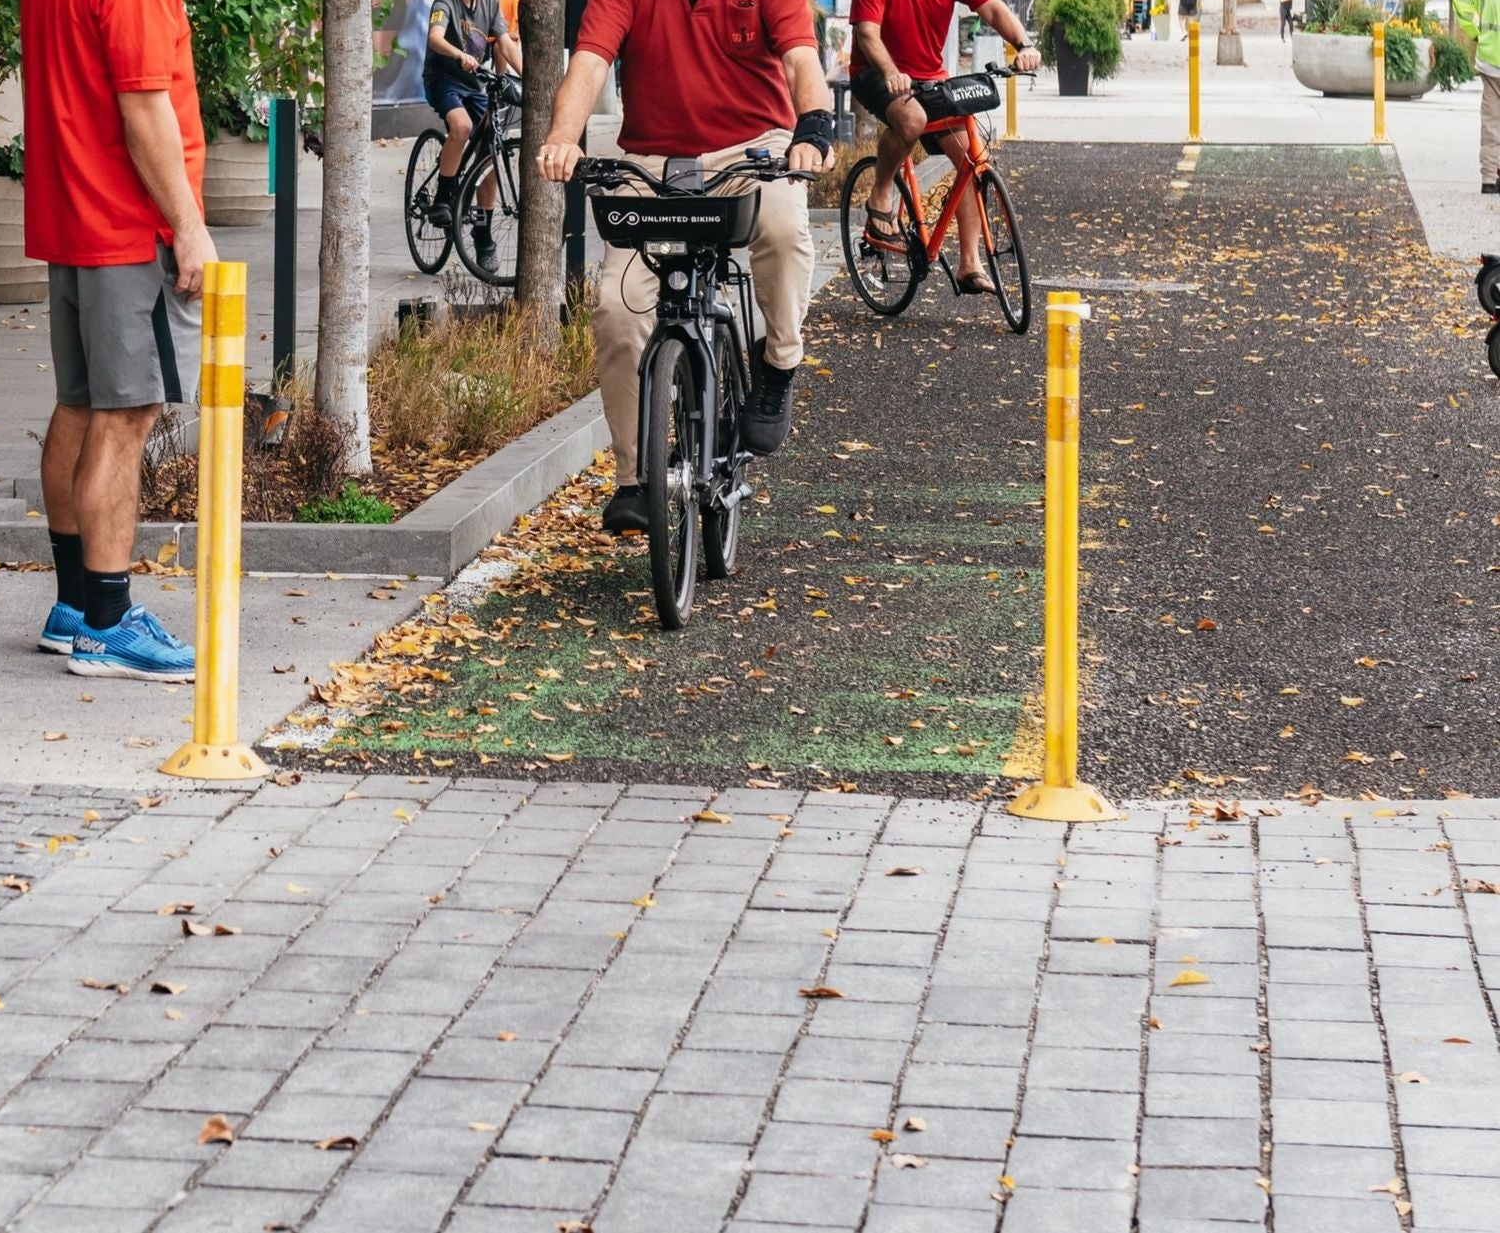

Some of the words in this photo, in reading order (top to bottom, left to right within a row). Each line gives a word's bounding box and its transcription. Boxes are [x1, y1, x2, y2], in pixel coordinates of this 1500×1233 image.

[953, 89, 992, 102] BIKING
[641, 215, 688, 223] UNLIMITED
[690, 215, 721, 223] BIKING
